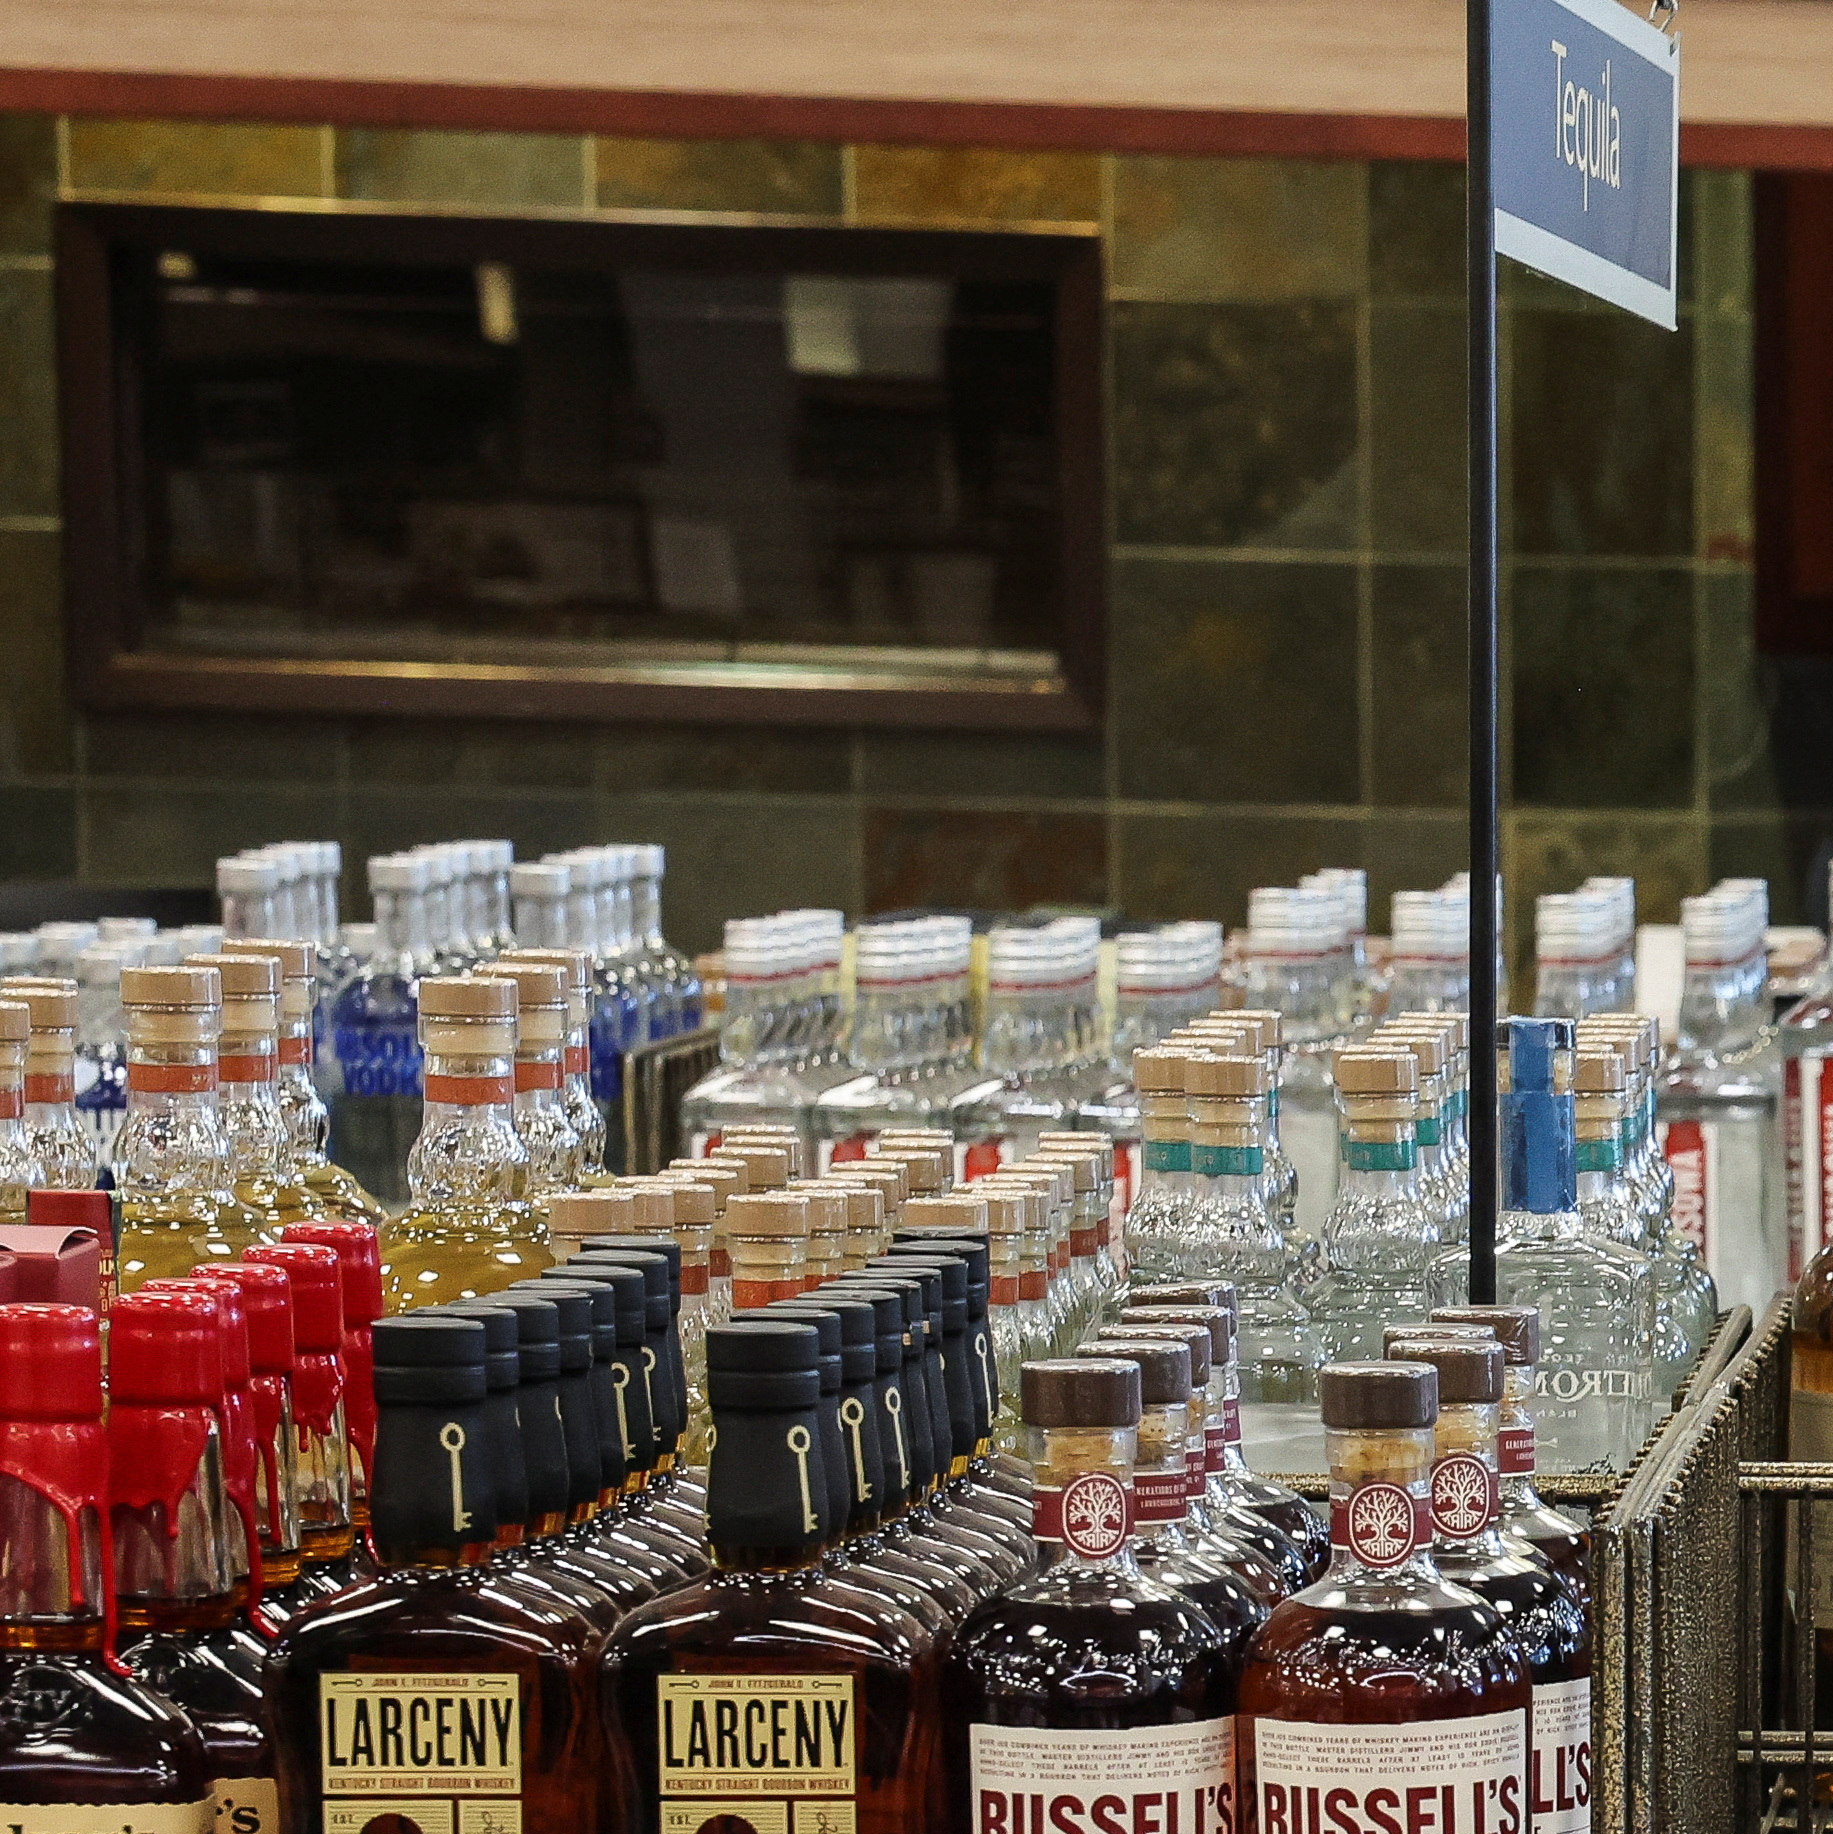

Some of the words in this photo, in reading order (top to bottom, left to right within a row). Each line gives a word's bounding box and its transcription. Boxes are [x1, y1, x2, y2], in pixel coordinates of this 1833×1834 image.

[1551, 40, 1620, 211] Tequila
[326, 1697, 514, 1767] LARCENY
[664, 1699, 848, 1768] LARCENY
